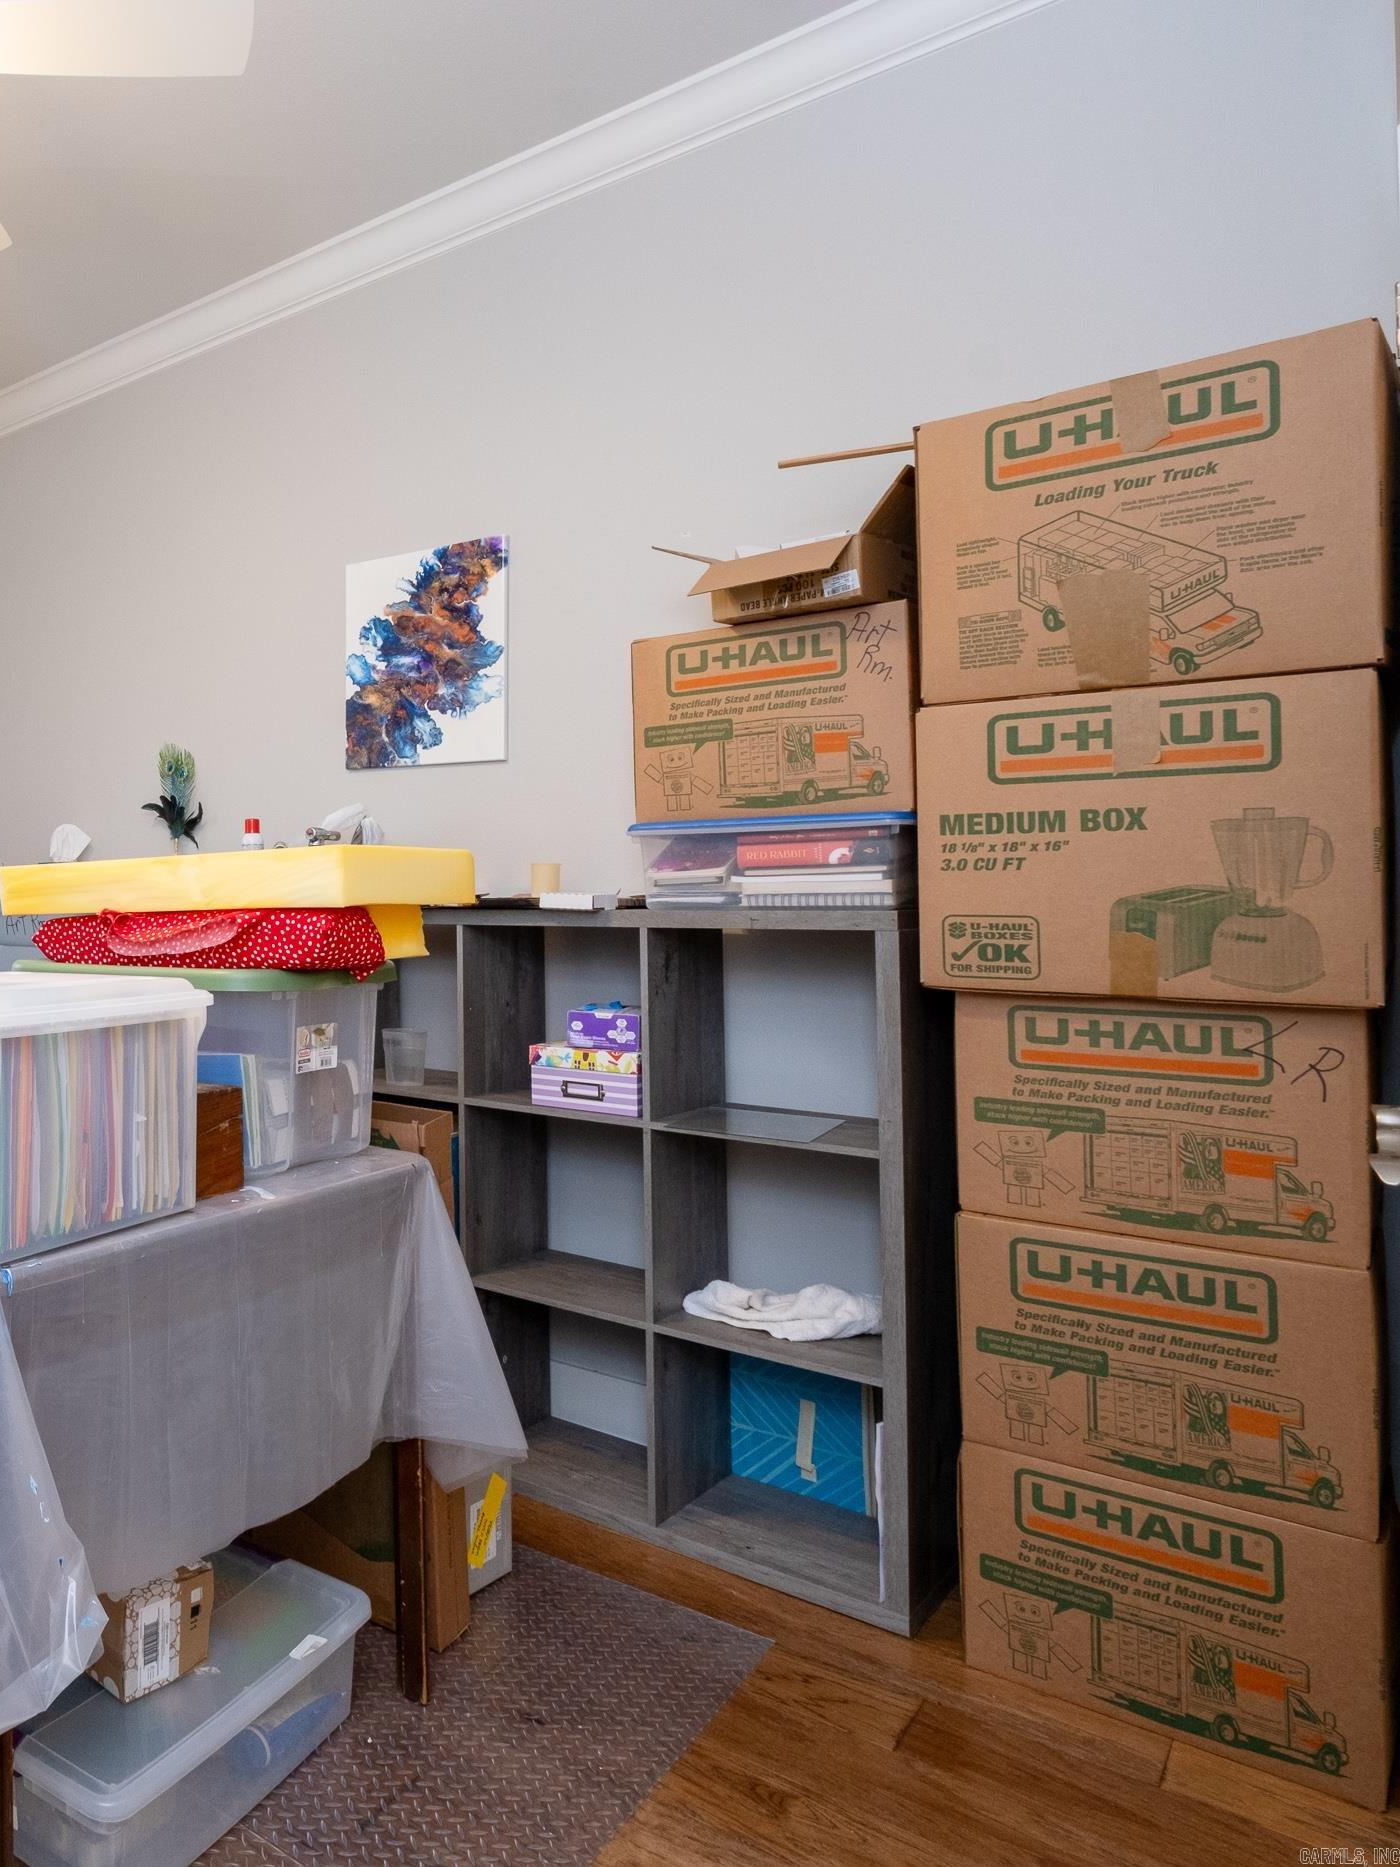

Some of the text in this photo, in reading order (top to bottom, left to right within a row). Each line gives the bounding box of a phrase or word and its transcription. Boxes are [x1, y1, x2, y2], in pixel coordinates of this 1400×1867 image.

[1003, 381, 1258, 459] U-HUL
[1034, 482, 1105, 508] Loading
[1113, 472, 1156, 493] Your
[1163, 461, 1220, 483] Truck
[1170, 568, 1222, 600] U-HAUL
[740, 600, 761, 612] BEAD
[846, 611, 897, 646] Art
[677, 633, 835, 675] U-HAUL
[668, 712, 678, 721] to
[680, 709, 704, 720] Make
[706, 706, 744, 719] Packing
[746, 703, 765, 713] and
[767, 699, 807, 711] Loading
[670, 683, 847, 712] Specifically Sized and Manufactured
[814, 723, 848, 731] U-HAUL
[1006, 709, 1259, 756] U-HUL
[939, 807, 1148, 836] MEDIUM BOX
[746, 850, 768, 861] RED
[769, 848, 807, 860] RABBIT
[940, 843, 957, 854] 18
[988, 844, 997, 853] x
[1002, 841, 1026, 853] 18"
[1030, 843, 1040, 852] x
[1044, 840, 1070, 852] 16"
[940, 857, 1027, 871] 3.0 CU FT
[970, 922, 1033, 932] U-HAUL
[970, 931, 1033, 941] BOXES
[977, 942, 1032, 963] OK
[950, 963, 1032, 974] FOR SHIPPING
[1024, 1016, 1254, 1058] U-HAUL
[1011, 1086, 1025, 1097] to
[1028, 1088, 1063, 1101] Make
[1067, 1092, 1121, 1107] Packing
[1124, 1096, 1152, 1108] and
[1155, 1099, 1216, 1116] Loading
[1014, 1074, 1273, 1106] Specifically Sized and Manufactured
[1225, 1137, 1274, 1153] U-HAUL
[1026, 1250, 1258, 1315] U-HAUL
[1014, 1320, 1027, 1331] to
[1030, 1323, 1066, 1339] Make
[1069, 1331, 1124, 1352] Packing
[1128, 1342, 1155, 1355] and
[1159, 1349, 1219, 1369] Loading
[1016, 1308, 1278, 1364] Specifically Sized and Manufactured
[1229, 1393, 1280, 1414] U-HAUL
[1031, 1482, 1264, 1573] U-HAUL
[1018, 1551, 1031, 1563] to
[1034, 1556, 1070, 1575] Make
[1074, 1569, 1129, 1596] Packing
[1132, 1587, 1161, 1603] and
[1165, 1595, 1224, 1623] Loading
[1020, 1538, 1097, 1572] Specifically
[1100, 1558, 1140, 1582] Sized
[1143, 1573, 1171, 1593] and
[1174, 1584, 1284, 1623] Manufactured
[1235, 1649, 1285, 1674] U-HAUL
